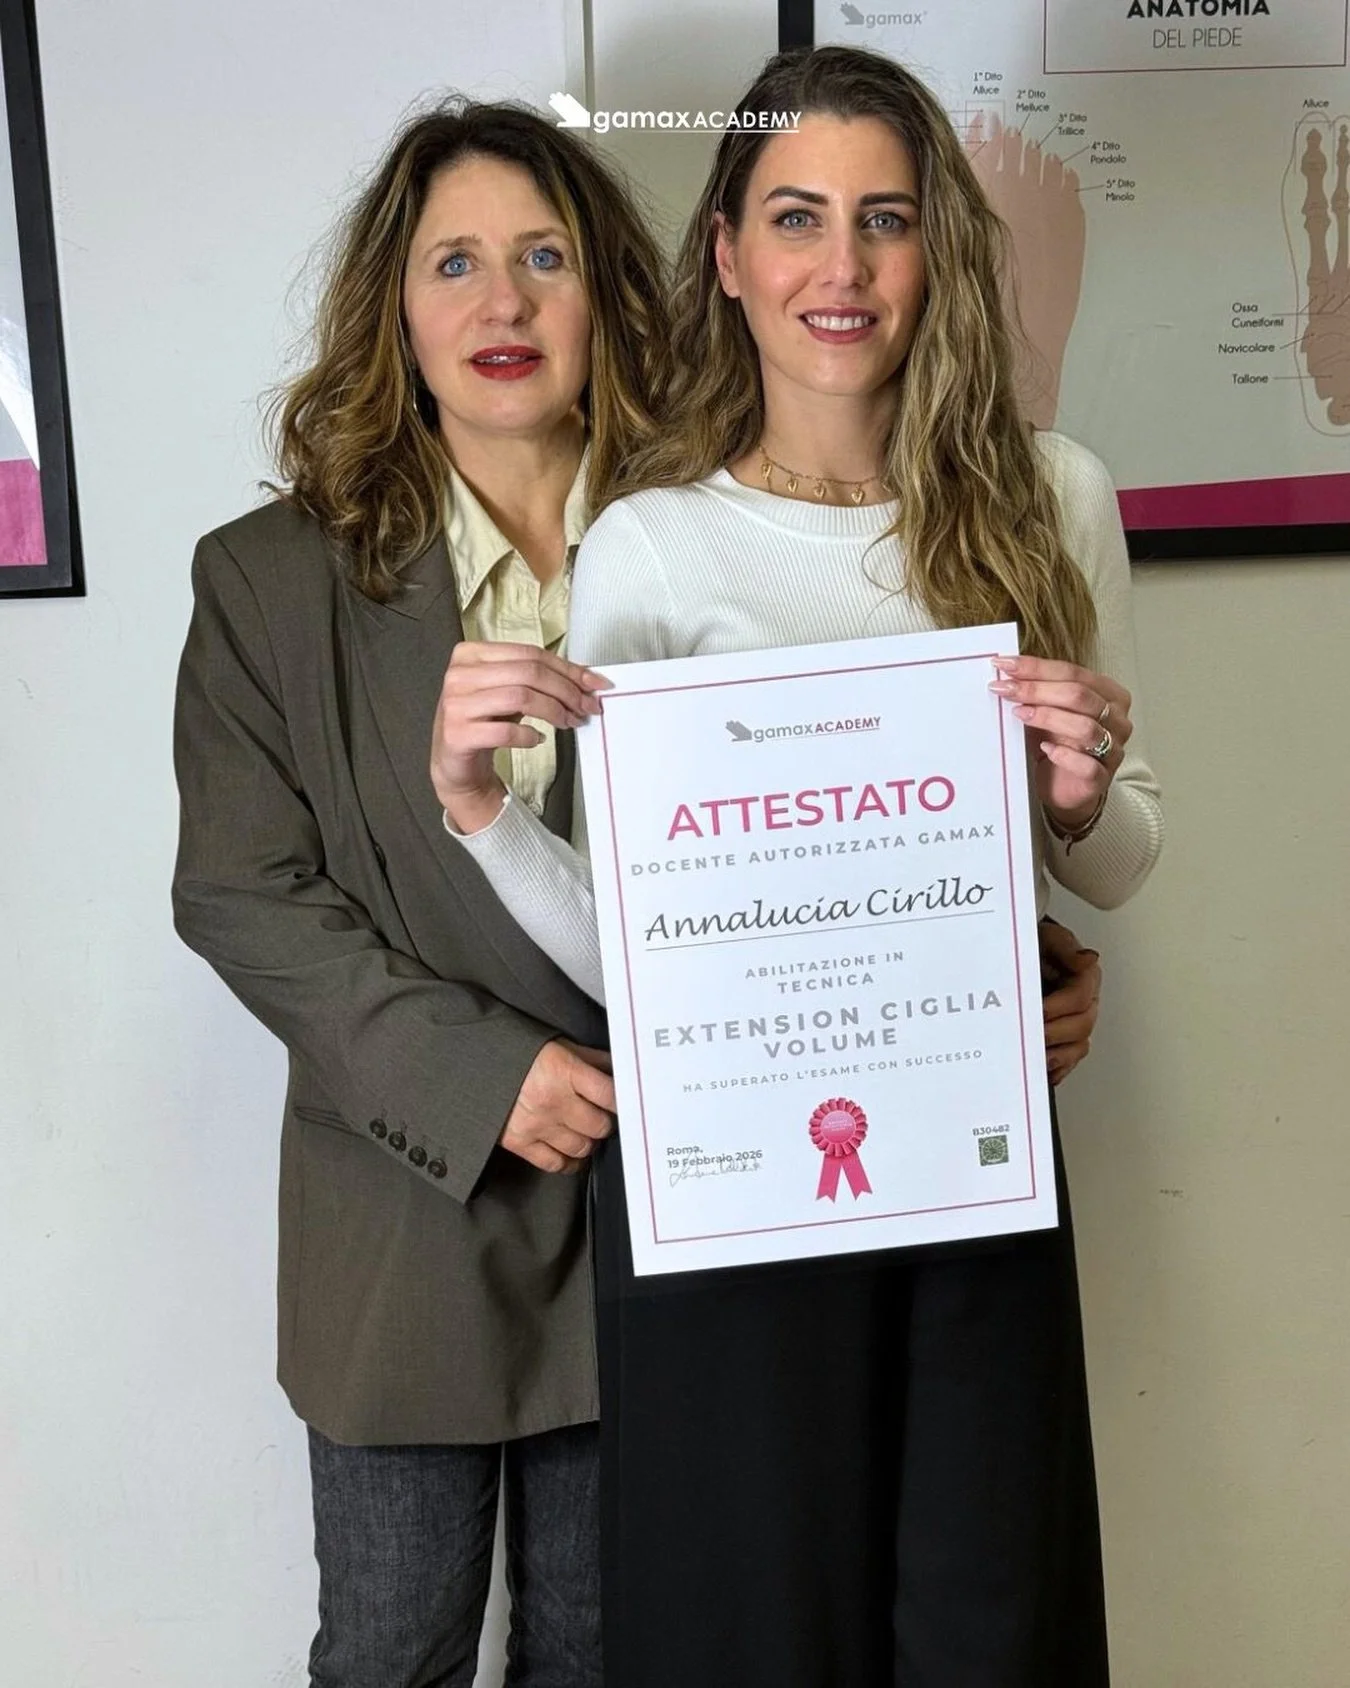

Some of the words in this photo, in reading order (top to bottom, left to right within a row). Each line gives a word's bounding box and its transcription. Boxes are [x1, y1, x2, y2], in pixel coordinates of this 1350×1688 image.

[1127, 0, 1270, 18] ANATOMIA
[1153, 29, 1186, 48] DEL
[1193, 27, 1243, 47] PIEDE
[985, 72, 1003, 81] Dito
[973, 86, 1000, 94] Alluce
[1028, 90, 1046, 99] Dito
[1016, 103, 1050, 112] Melluce
[1303, 99, 1330, 108] Alluce
[1069, 113, 1088, 122] Dito
[1102, 141, 1120, 150] Dito
[1118, 179, 1135, 187] Dito
[1232, 302, 1258, 313] Ossa
[1218, 343, 1275, 353] Navicolare
[1232, 374, 1268, 384] Tallone
[666, 775, 956, 841] ATTESTATO
[631, 853, 736, 876] DOCENTE
[749, 835, 906, 864] AUTORIZZATA
[918, 824, 996, 845] GAMAX
[645, 897, 860, 941] Annalucia
[866, 875, 993, 917] Cirillo
[745, 954, 877, 979] ABILITAZIONE
[886, 951, 904, 963] IN
[777, 972, 874, 994] TECNICA
[655, 1007, 860, 1048] EXTENSION
[881, 990, 1003, 1022] CIGLIA
[764, 1028, 898, 1059] VOLUME
[683, 1082, 703, 1093] HA
[711, 1073, 789, 1090] SUPERATO
[868, 1059, 898, 1071] CON
[905, 1049, 983, 1067] SUCCESSO
[668, 1160, 679, 1168] 19
[683, 1154, 733, 1166] Febbraio
[735, 1150, 763, 1161] 2026
